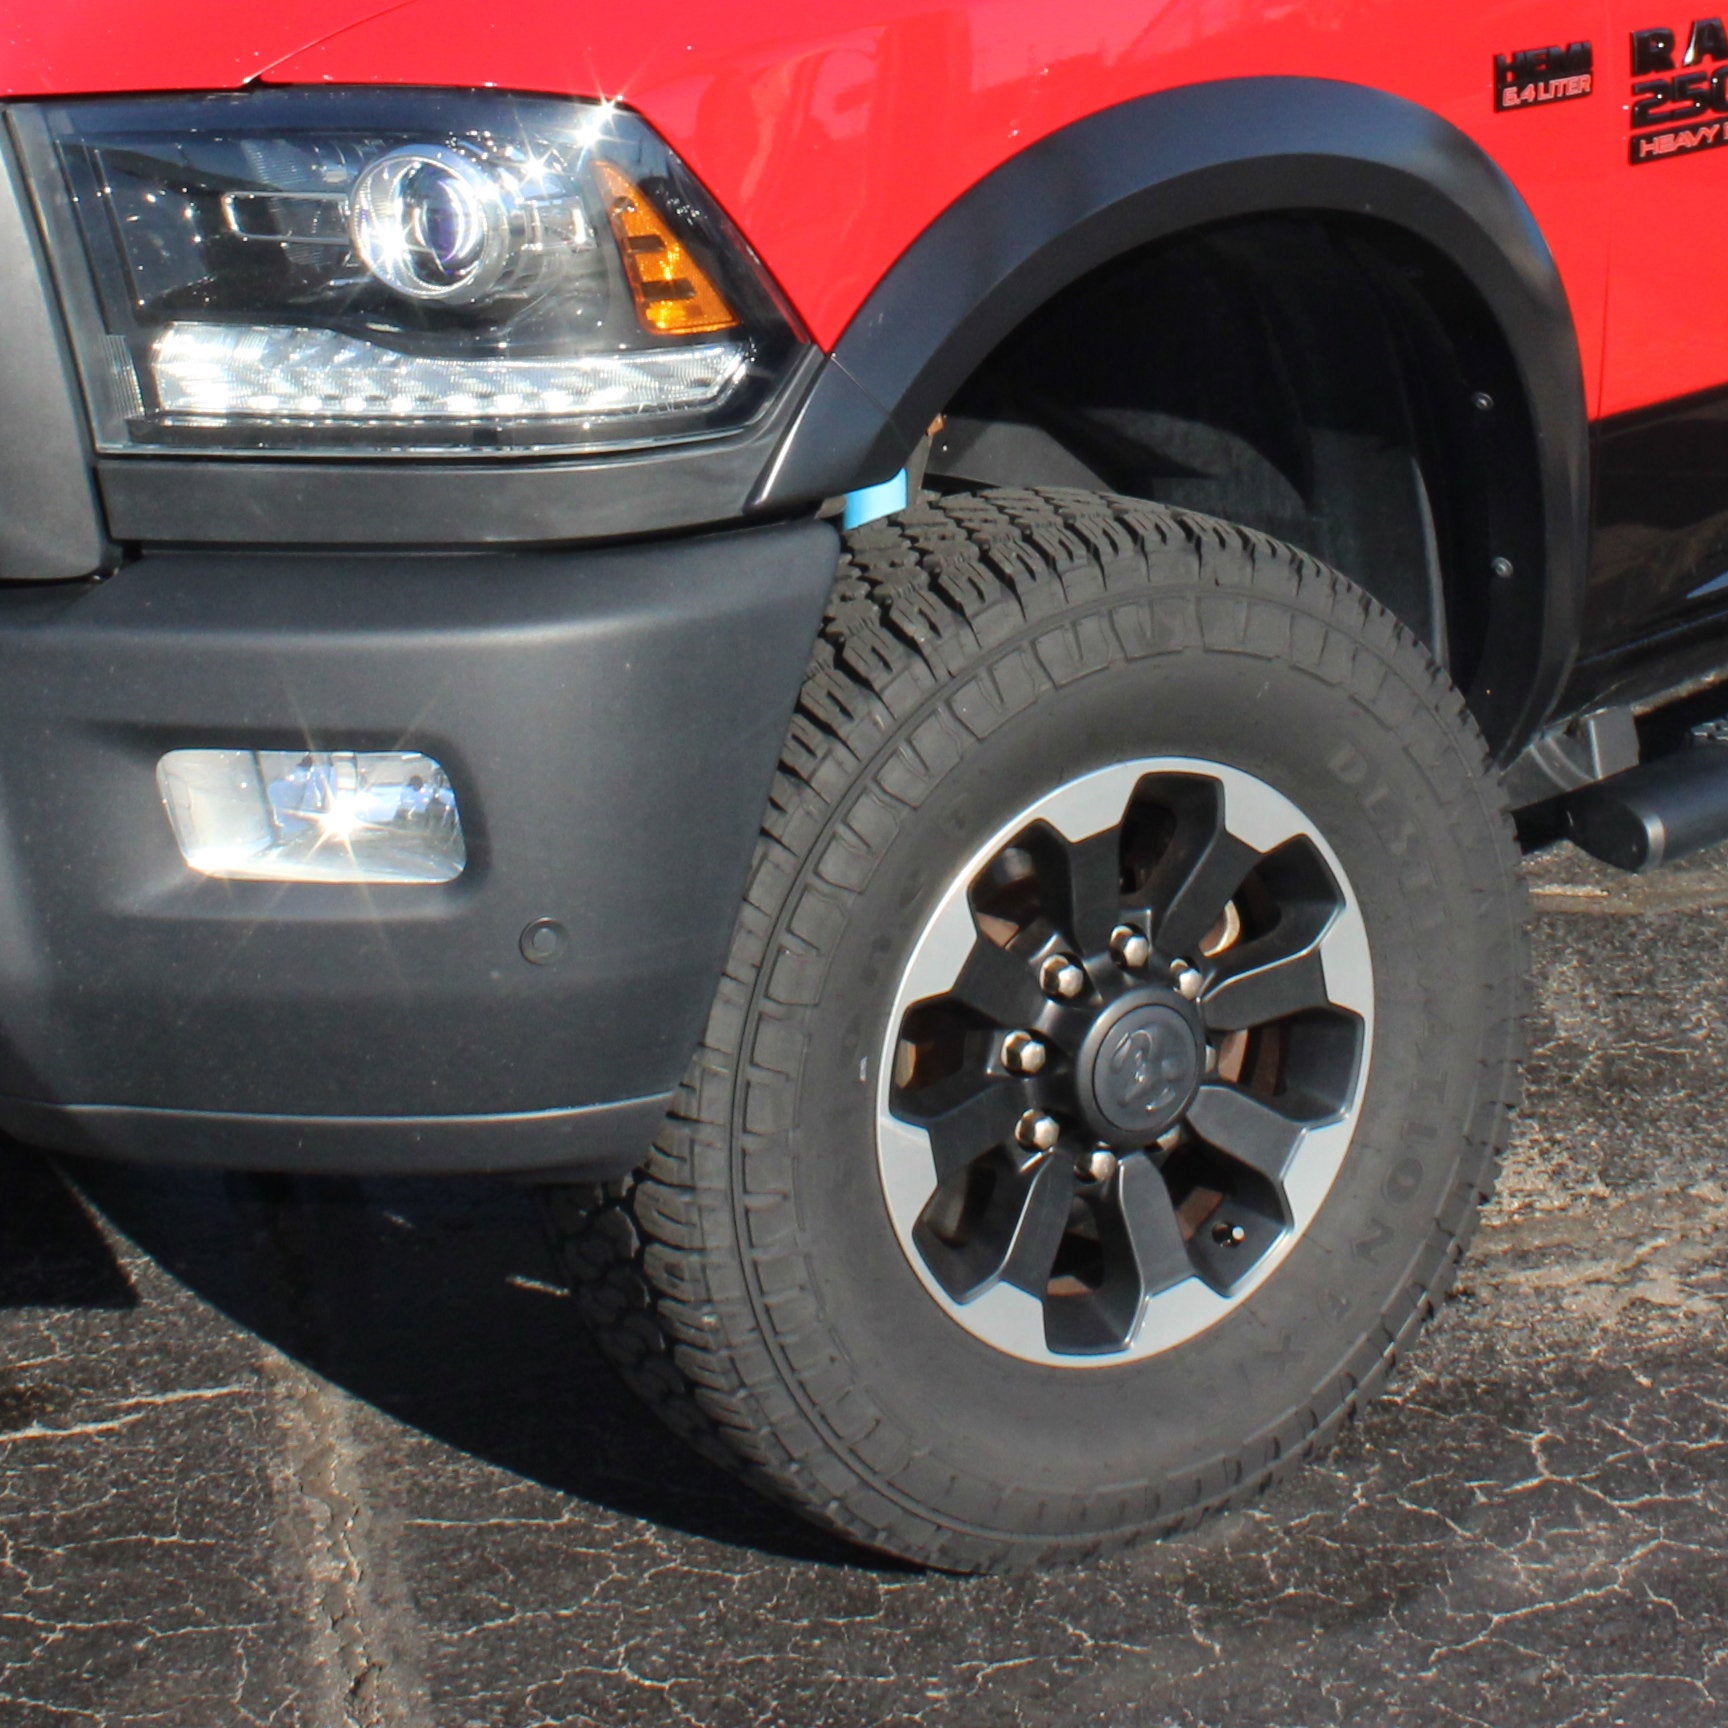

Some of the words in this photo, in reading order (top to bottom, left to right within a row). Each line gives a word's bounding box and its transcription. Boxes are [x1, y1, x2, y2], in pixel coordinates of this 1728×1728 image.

[1493, 40, 1593, 84] HEMI
[1502, 80, 1537, 107] 6.4
[1537, 73, 1592, 101] LITER
[1638, 122, 1721, 158] HEAVY
